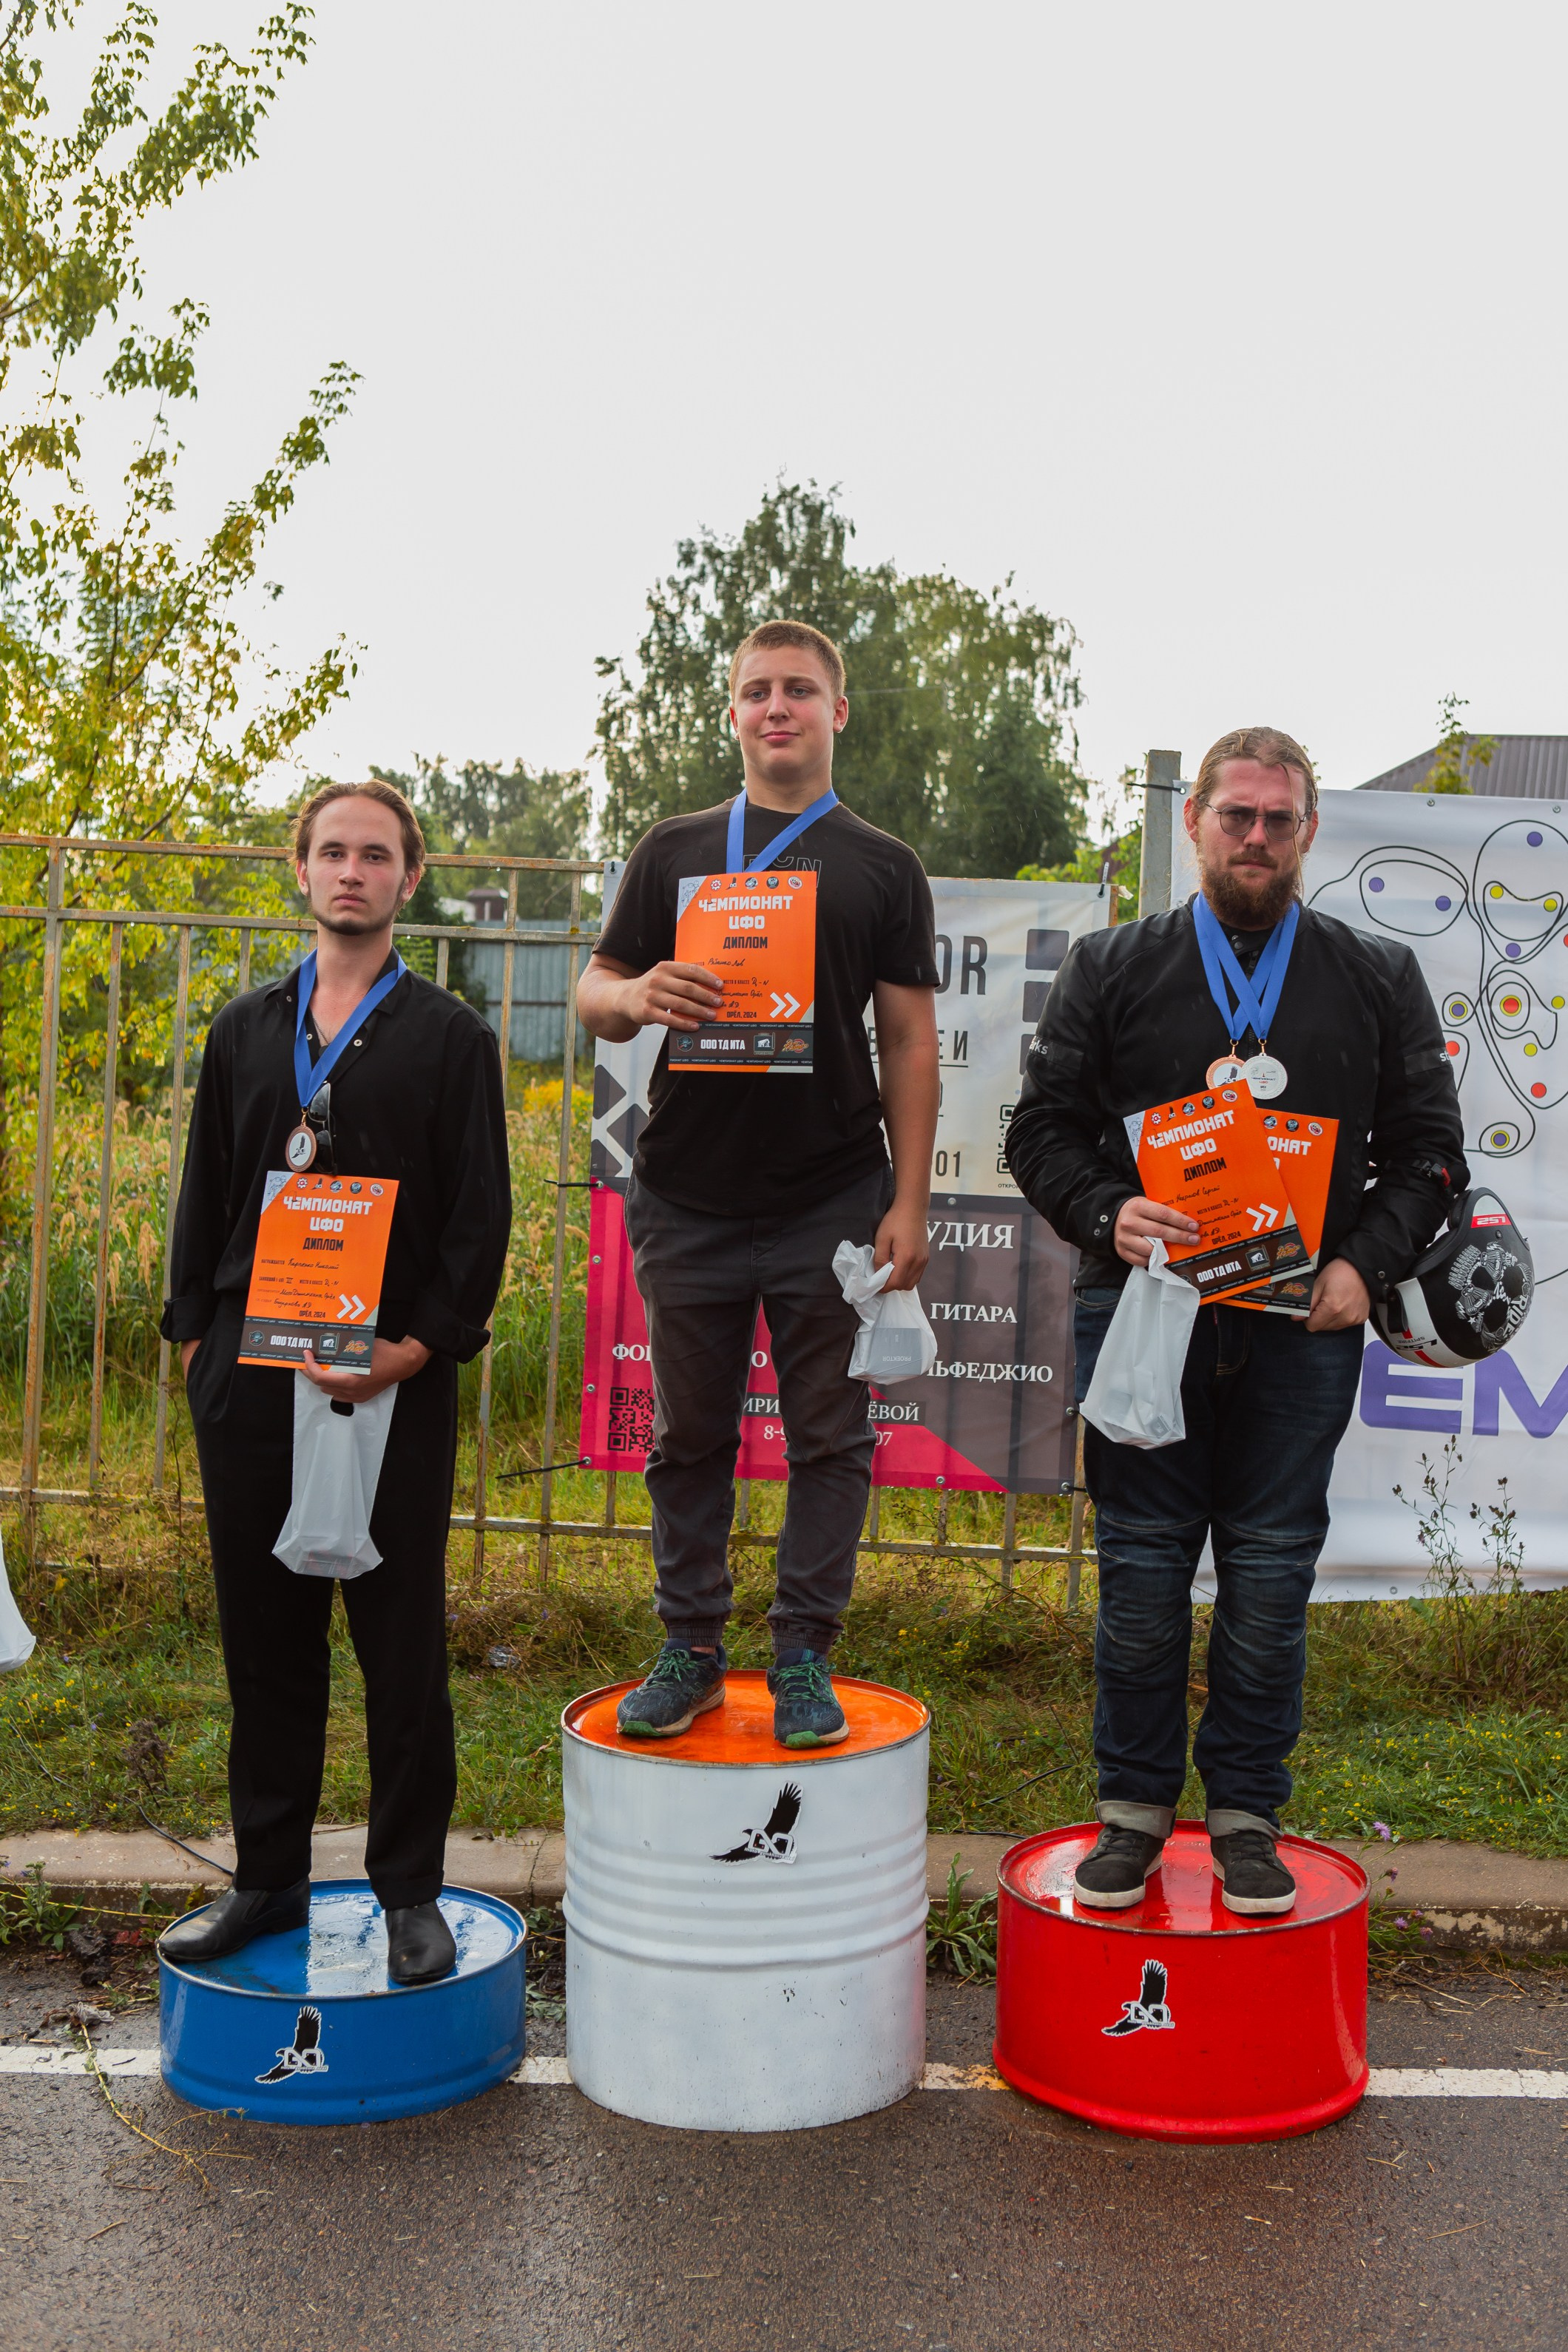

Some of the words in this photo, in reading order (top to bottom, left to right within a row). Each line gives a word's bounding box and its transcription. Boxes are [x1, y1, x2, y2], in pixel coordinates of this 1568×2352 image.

[698, 896, 793, 912] ЧЕМПИОНАТ
[729, 916, 765, 929] ЦФО
[723, 936, 768, 949] ДИПЛОМ
[700, 1039, 717, 1050] ООО
[719, 1039, 729, 1050] ТД
[730, 1040, 746, 1050] ИТА
[1146, 1110, 1235, 1149] ЧЕМПИОНАТ
[1180, 1138, 1217, 1160] ЦФО
[1183, 1157, 1227, 1182] ДИПЛОМ
[283, 1196, 373, 1215] ЧЕМПИОНАТ
[310, 1217, 343, 1232] ЦФО
[1476, 1216, 1506, 1226] LS2
[1226, 1231, 1241, 1241] 2024
[303, 1237, 343, 1251] ДИПЛОМ
[1196, 1270, 1215, 1283] ООО
[1214, 1266, 1226, 1278] ТД
[1225, 1260, 1243, 1274] ИТА
[930, 1302, 1018, 1324] ГИТАРА
[1503, 1294, 1530, 1337] RIDE
[270, 1335, 287, 1346] ООО
[287, 1336, 297, 1348] ТД
[298, 1337, 313, 1349] ИТА
